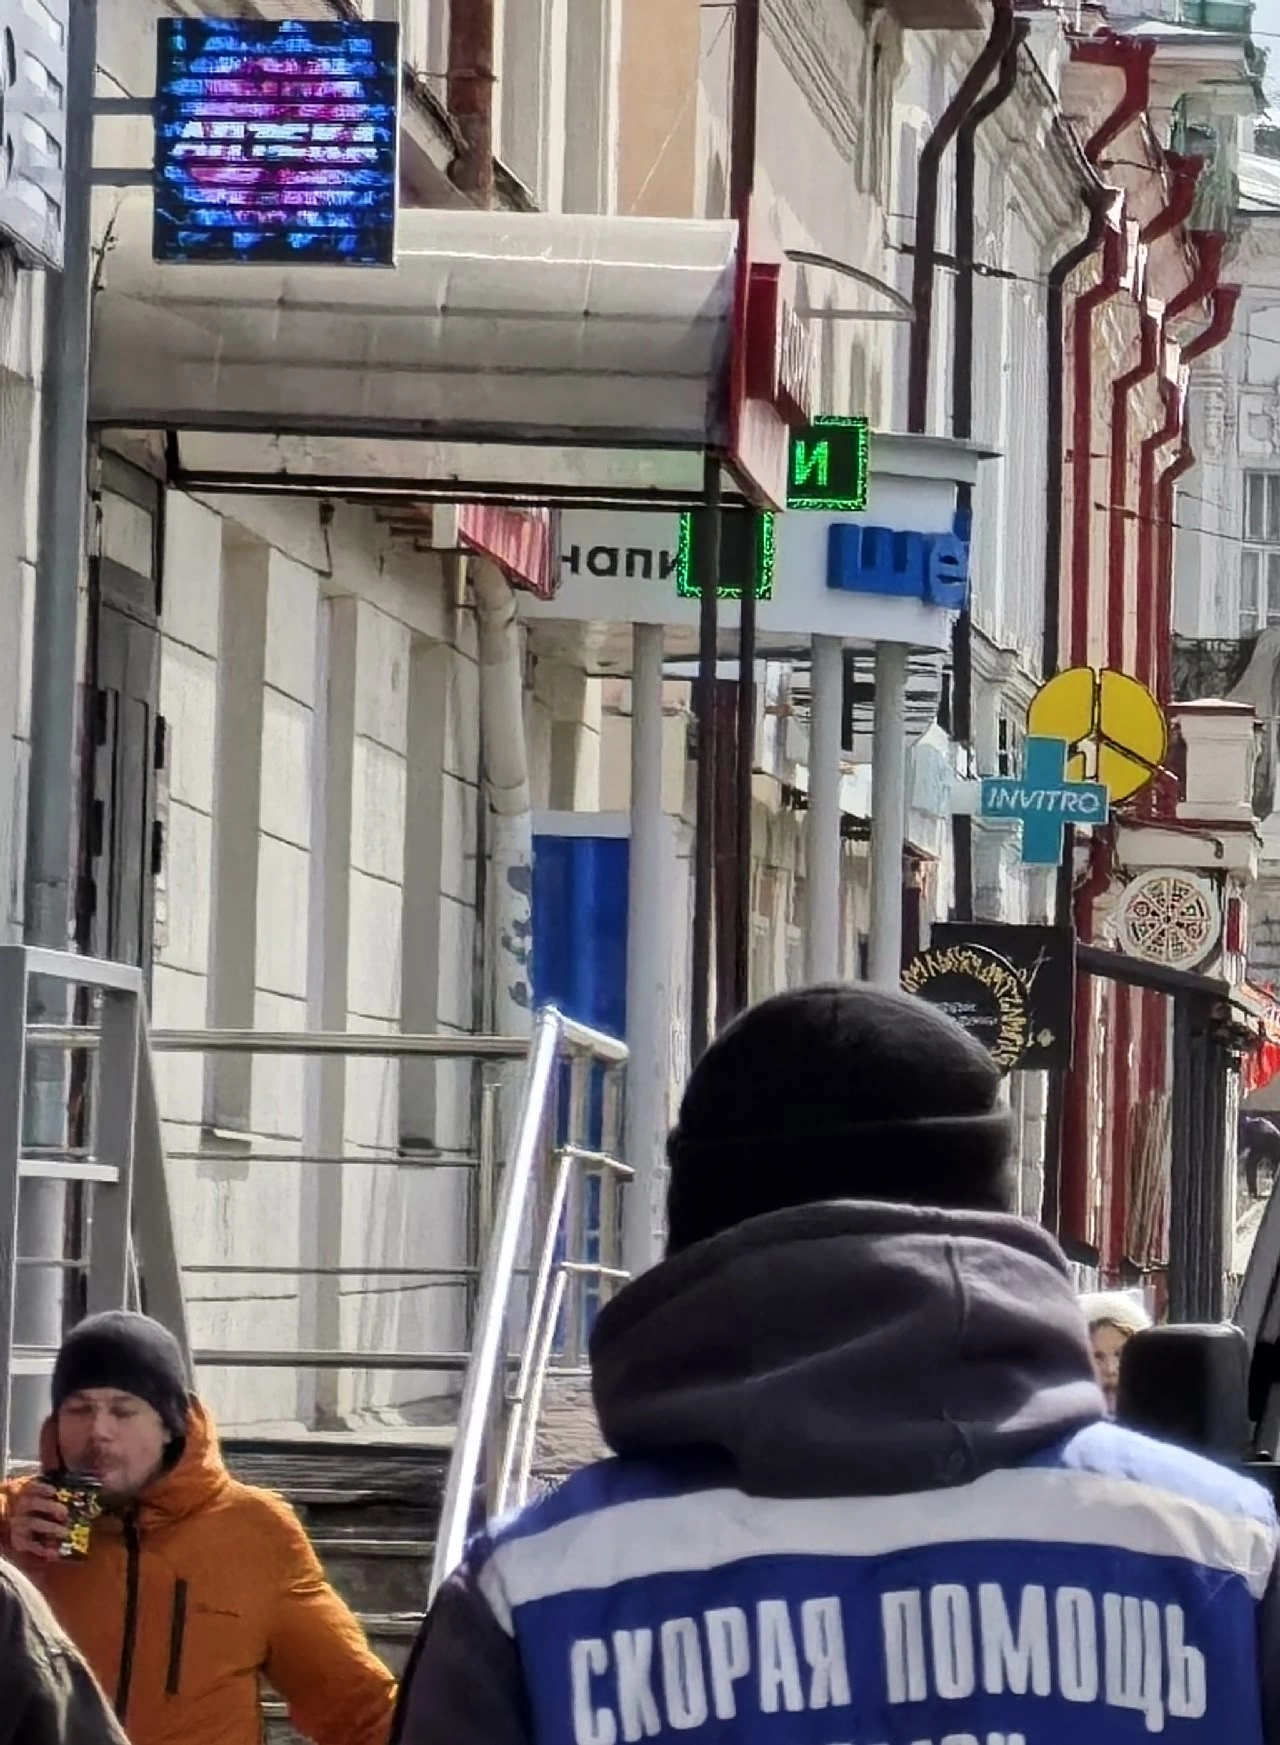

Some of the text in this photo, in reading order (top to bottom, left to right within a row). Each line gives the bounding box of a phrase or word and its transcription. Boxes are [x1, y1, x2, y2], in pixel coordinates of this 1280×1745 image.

[987, 786, 1100, 814] INVITRO
[570, 1582, 1207, 1745] СКОРАЯ ПОМОЩЬ
